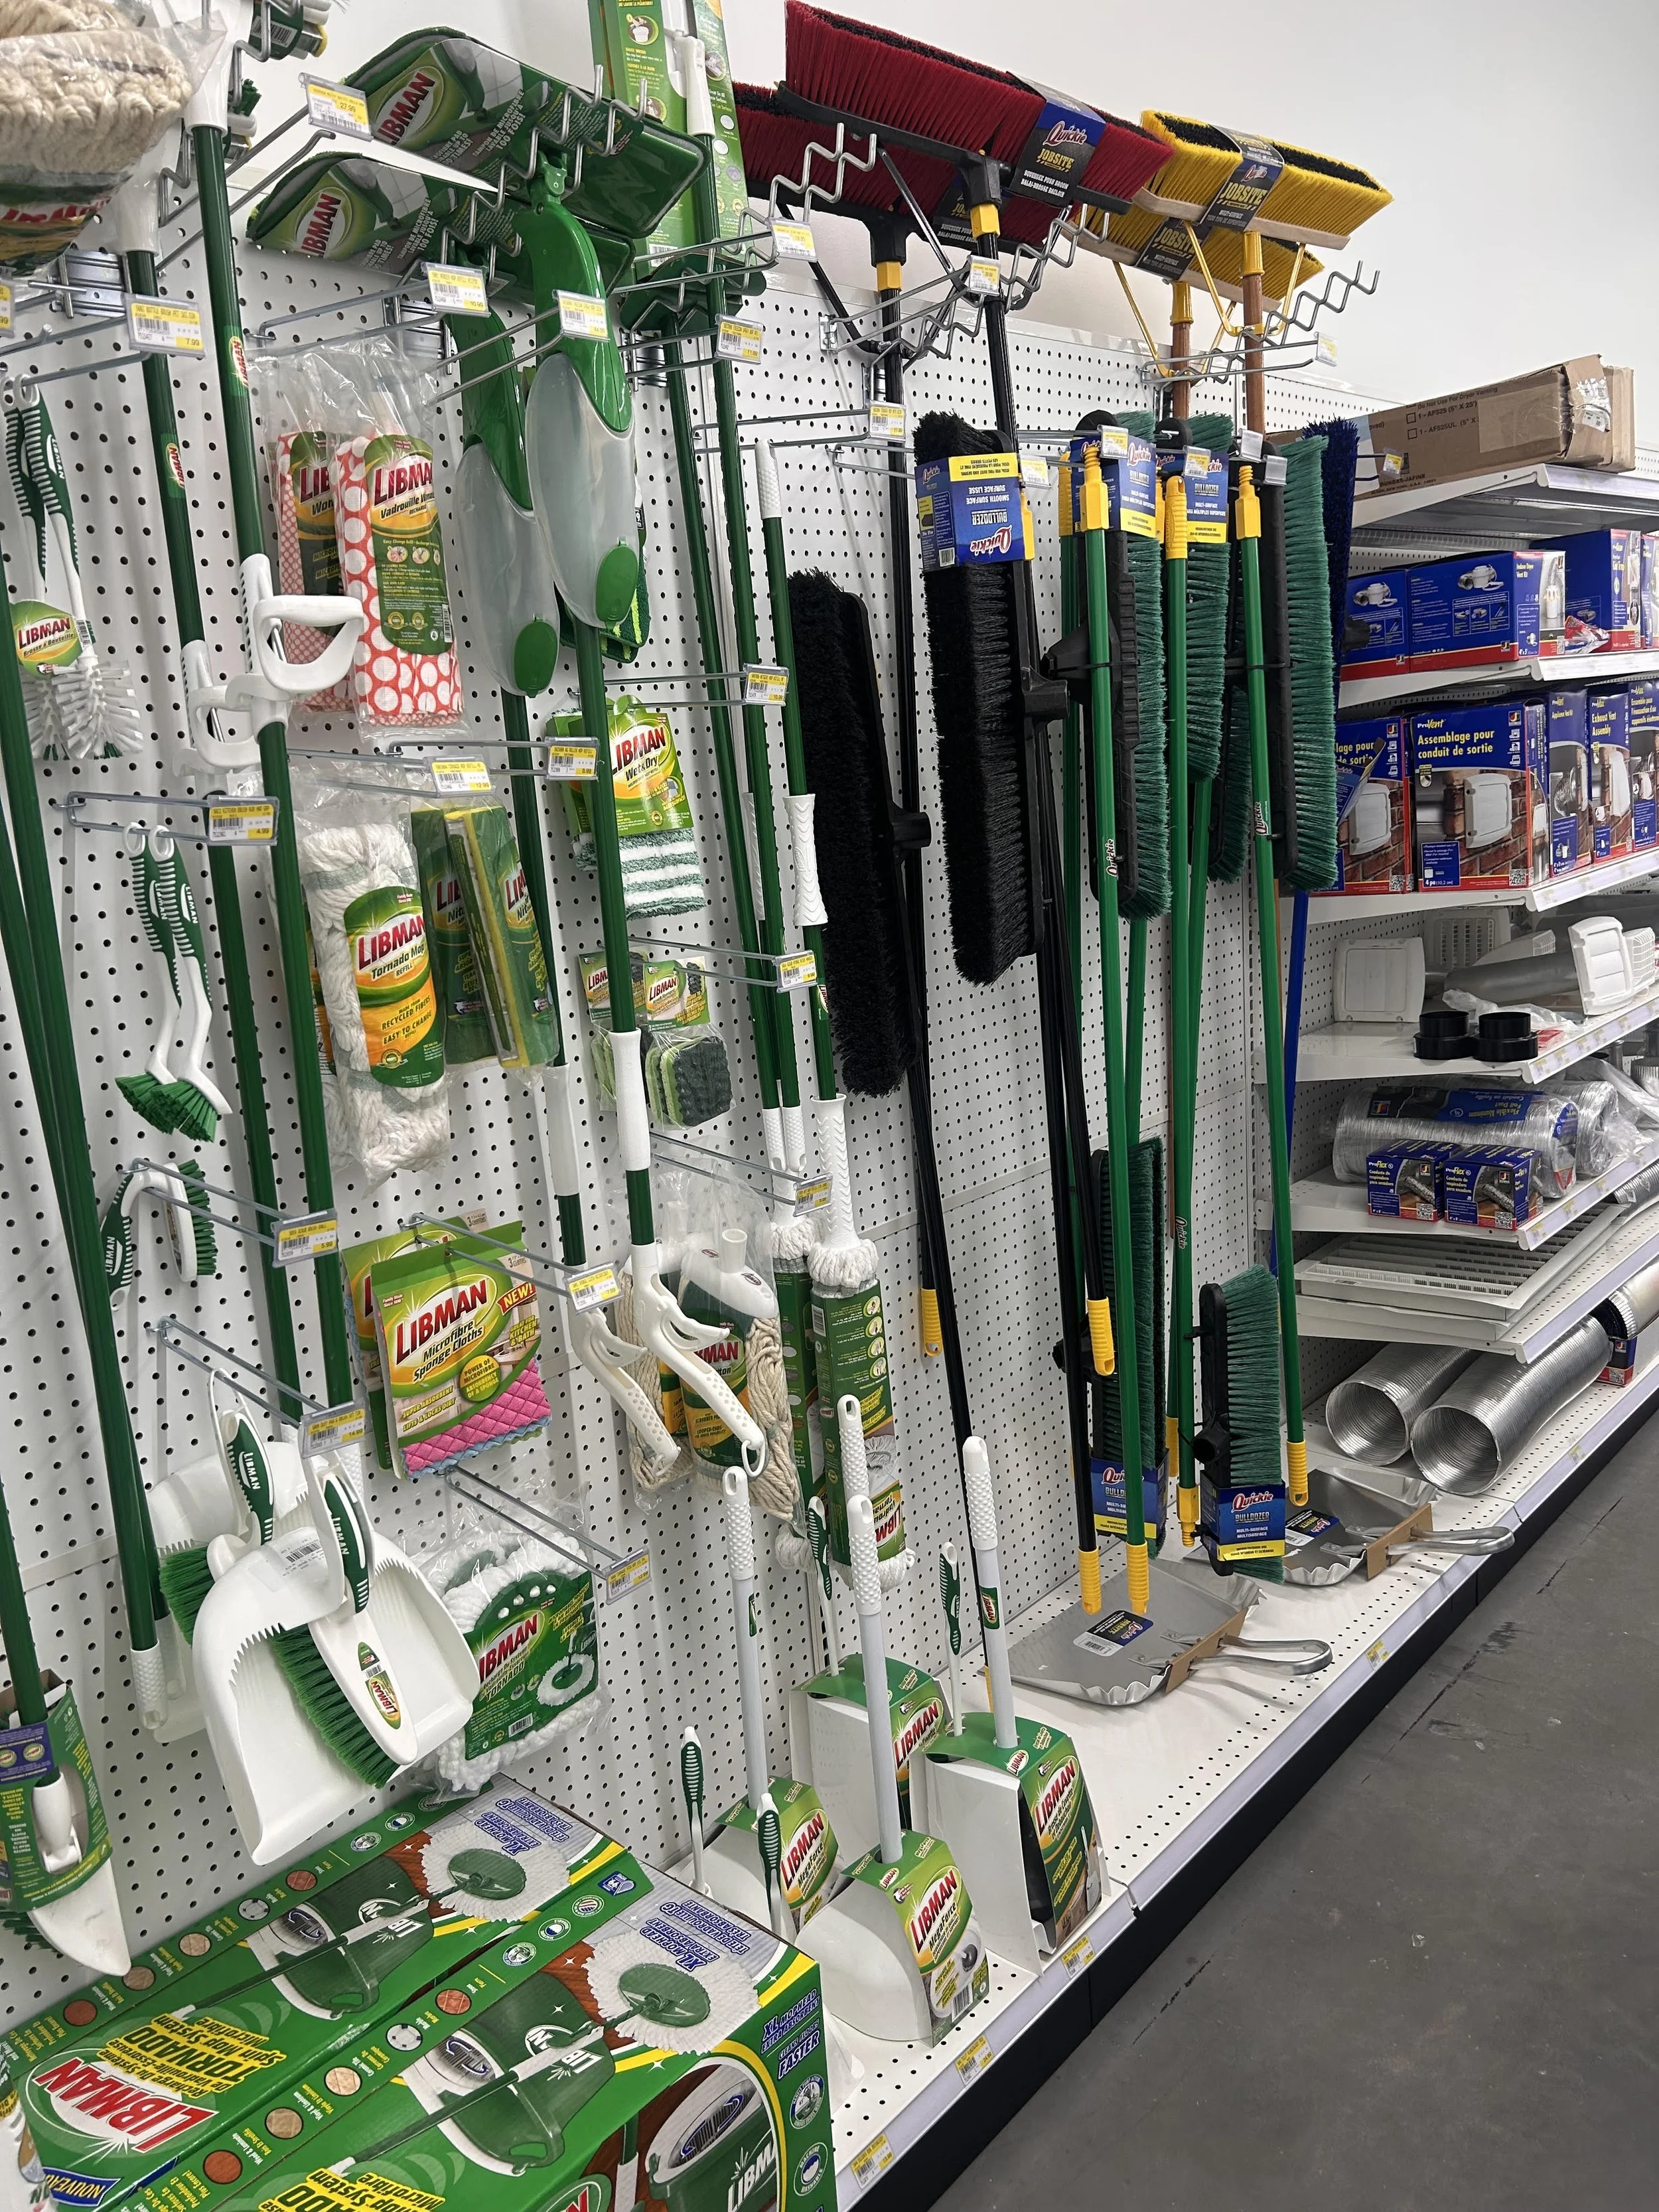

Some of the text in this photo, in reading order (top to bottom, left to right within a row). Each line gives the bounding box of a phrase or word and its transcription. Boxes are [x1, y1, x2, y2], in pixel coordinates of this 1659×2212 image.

[496, 113, 526, 150] 100 FOIS!
[1042, 120, 1087, 147] Quickie
[1037, 148, 1074, 170] JOBSITE
[1220, 182, 1268, 206] JOBSITE
[417, 217, 439, 252] 100 FOIS!
[186, 338, 200, 346] 7.99
[1459, 392, 1475, 402] Dryer
[1476, 386, 1498, 396] Venting
[52, 438, 65, 479] LIBMAN
[1127, 442, 1151, 467] Quickie
[968, 486, 983, 494] LISSE
[1129, 470, 1149, 487] BULLDOZER
[1194, 482, 1219, 496] BULLDOZER
[381, 498, 420, 519] Vadrouille
[966, 494, 1009, 504] SMOOTH SURFACE
[971, 510, 1008, 526] BULLDOZER
[970, 524, 1013, 556] Quickie
[18, 617, 71, 649] LIBMAN
[1417, 719, 1445, 729] ProVent
[1592, 711, 1617, 723] Exhaust Vent
[1592, 725, 1611, 737] Assembly
[1356, 741, 1374, 751] pour
[1417, 729, 1495, 745] Assemblage pour
[1417, 744, 1493, 759] conduit de sortie
[625, 755, 658, 782] Wet&Dry
[1255, 802, 1269, 836] Quickie
[1106, 838, 1119, 877] Quickie
[186, 887, 198, 924] LIBMAN
[358, 915, 425, 970] LIBMAN
[372, 944, 425, 980] Tornado Mop
[396, 964, 413, 978] REFILL
[649, 977, 677, 1000] LIBMAN
[382, 995, 431, 1030] RECYCLED FIBERS
[383, 1010, 432, 1045] EASY TO CHANGE
[1445, 1166, 1465, 1175] ProFlex
[467, 1216, 472, 1227] 3
[1175, 1215, 1187, 1250] Quickie
[106, 1235, 116, 1274] LIBMAN
[321, 1241, 333, 1250] 5.99
[509, 1258, 513, 1268] 3
[503, 1284, 534, 1308] NEW!
[396, 1280, 488, 1366] LIBMAN
[510, 1319, 538, 1339] KITCHEN
[517, 1328, 535, 1343] BATH
[413, 1326, 483, 1382] Sponge Cloths
[423, 1321, 474, 1363] Microfibre
[463, 1363, 496, 1382] MICROFIBRE
[464, 1364, 484, 1376] POWER
[466, 1372, 498, 1392] ABSORBENCY
[479, 1378, 499, 1392] SPONGE
[402, 1385, 454, 1418] SUPER ABSORBENT
[402, 1397, 456, 1432] LIFTS LOCKS DIRT
[348, 1429, 363, 1438] 14.99
[244, 1452, 261, 1491] LIBMAN
[1231, 1491, 1273, 1513] Quickie
[1235, 1511, 1269, 1523] BULLDOZER
[332, 1516, 350, 1555] LIBMAN
[638, 1571, 648, 1580] 12.99
[983, 1593, 995, 1623] LIBMAN
[1120, 1621, 1143, 1640] Quickie
[486, 1661, 525, 1702] TORNADO
[371, 1680, 399, 1715] LIBMAN
[894, 1701, 939, 1769] LIBMAN
[1007, 1751, 1028, 1775] LIBMAN
[516, 1797, 557, 1823] ABSORBANTE
[1035, 1759, 1075, 1834] LIBMAN
[481, 1812, 541, 1848] EXTRA ABSORBENT
[496, 1799, 547, 1832] VADROUILLE TG
[474, 1818, 530, 1856] XL MOPHEAD
[780, 1811, 824, 1891] LIBMAN
[798, 1842, 824, 1887] MegaForce
[881, 1868, 897, 1889] LIBMAN
[681, 1900, 751, 1941] TRÈS ABSORBANTE
[910, 1869, 958, 1954] LIBMAN
[929, 1901, 956, 1951] MegaForce
[646, 1918, 720, 1962] EXTRA ABSORBENT
[660, 1902, 751, 1955] TÊTE DE VADROUILLE TG
[639, 1926, 707, 1972] XL MOPHEAD
[474, 1977, 487, 1988] Pierre
[760, 1996, 820, 2053] EXTRA ABSORBENT
[762, 1988, 818, 2041] XL MOPHEAD
[151, 2015, 285, 2067] Spin Mop System
[196, 2017, 269, 2047] Microfibre
[778, 2019, 820, 2059] CLEANS FLOORS
[108, 2039, 232, 2092] De Vadrouille-Essoreuse
[123, 2026, 258, 2083] TORNADO
[778, 2030, 820, 2080] FASTER
[98, 2049, 208, 2098] Recharge Du Système
[31, 2056, 220, 2154] LIBMAN
[313, 2107, 325, 2121] Vinyl
[232, 2132, 263, 2166] Wood Laminate
[261, 2146, 272, 2156] Bois
[799, 2146, 821, 2168] MACHINE
[179, 2169, 210, 2199] Plus Encore!
[309, 2170, 375, 2207] System
[358, 2172, 445, 2211] Microfibre
[800, 2169, 824, 2194] WASHABLE
